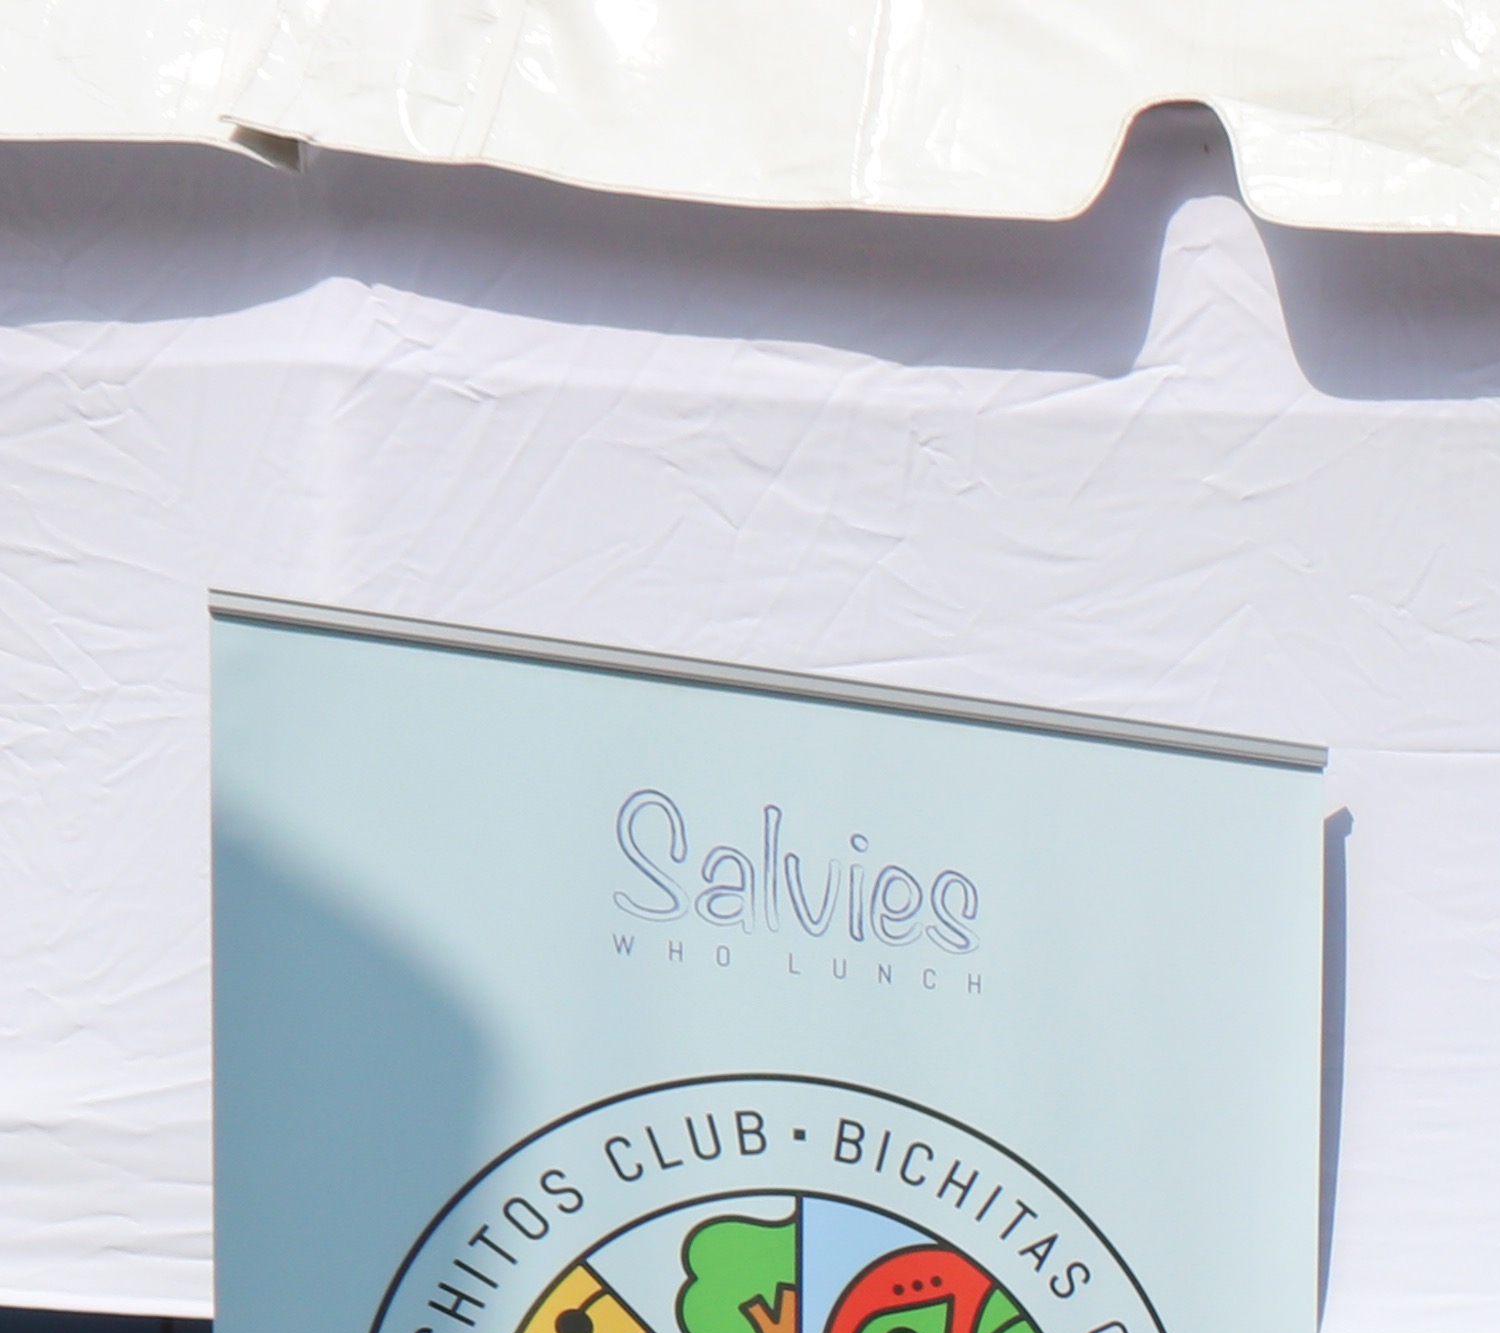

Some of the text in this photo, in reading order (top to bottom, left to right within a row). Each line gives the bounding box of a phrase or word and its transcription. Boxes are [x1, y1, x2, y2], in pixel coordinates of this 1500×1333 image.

[612, 788, 980, 955] Salvies
[612, 933, 982, 994] WHO LUNCH
[604, 1109, 768, 1182] CLUB
[834, 1117, 1091, 1299] BICHITAS
